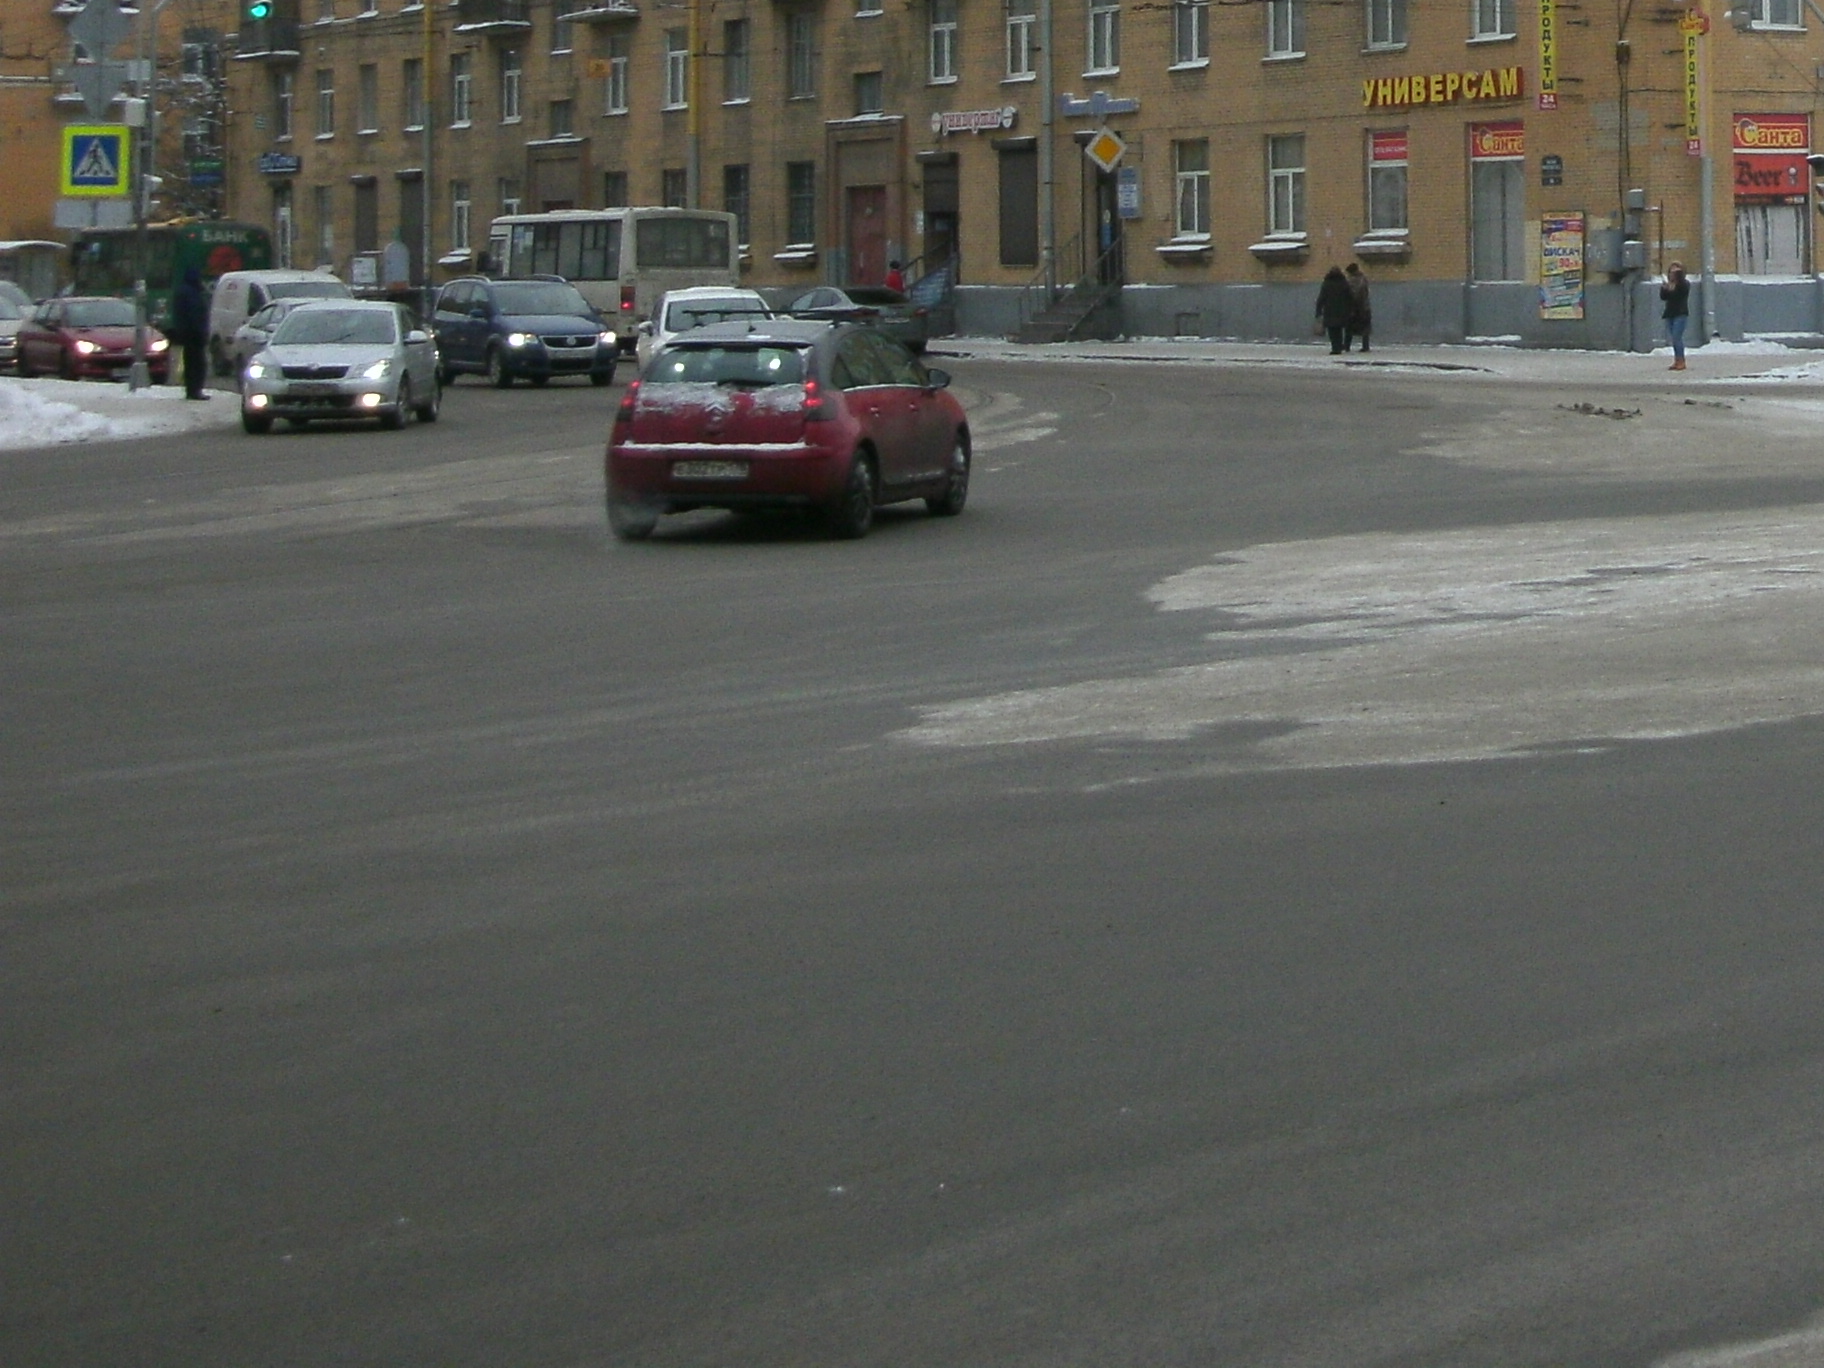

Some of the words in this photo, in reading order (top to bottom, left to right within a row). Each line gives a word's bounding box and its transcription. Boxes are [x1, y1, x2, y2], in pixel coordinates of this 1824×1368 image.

[1361, 66, 1519, 108] УНИВЕРСАМ
[1687, 36, 1698, 136] ПРОДУКТЫ
[1477, 129, 1524, 155] Санта
[1736, 119, 1803, 146] Санта
[1735, 161, 1782, 187] Beer
